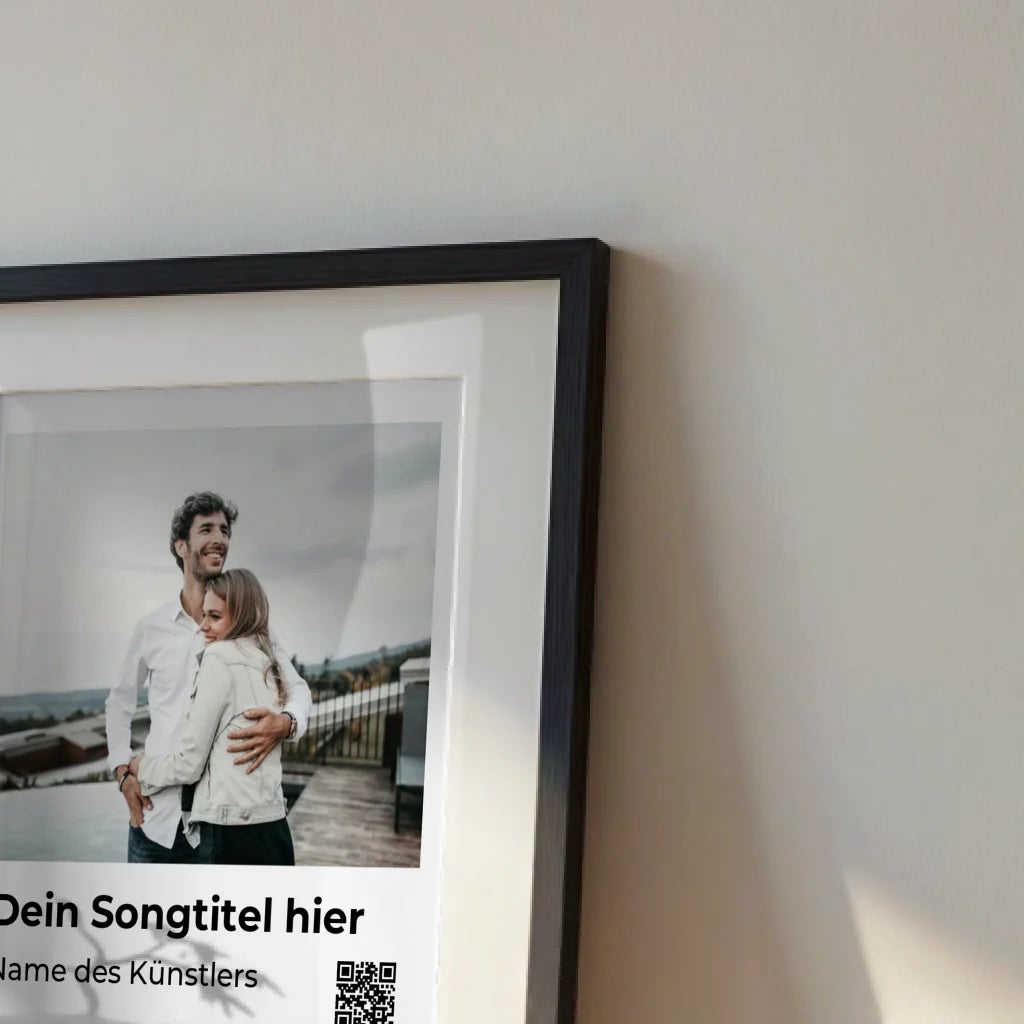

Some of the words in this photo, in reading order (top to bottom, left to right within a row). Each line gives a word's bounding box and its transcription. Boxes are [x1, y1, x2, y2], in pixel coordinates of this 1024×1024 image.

[90, 894, 273, 940] Songtitel
[285, 896, 365, 935] hier
[74, 957, 121, 984] des
[130, 959, 258, 988] Künstlers
